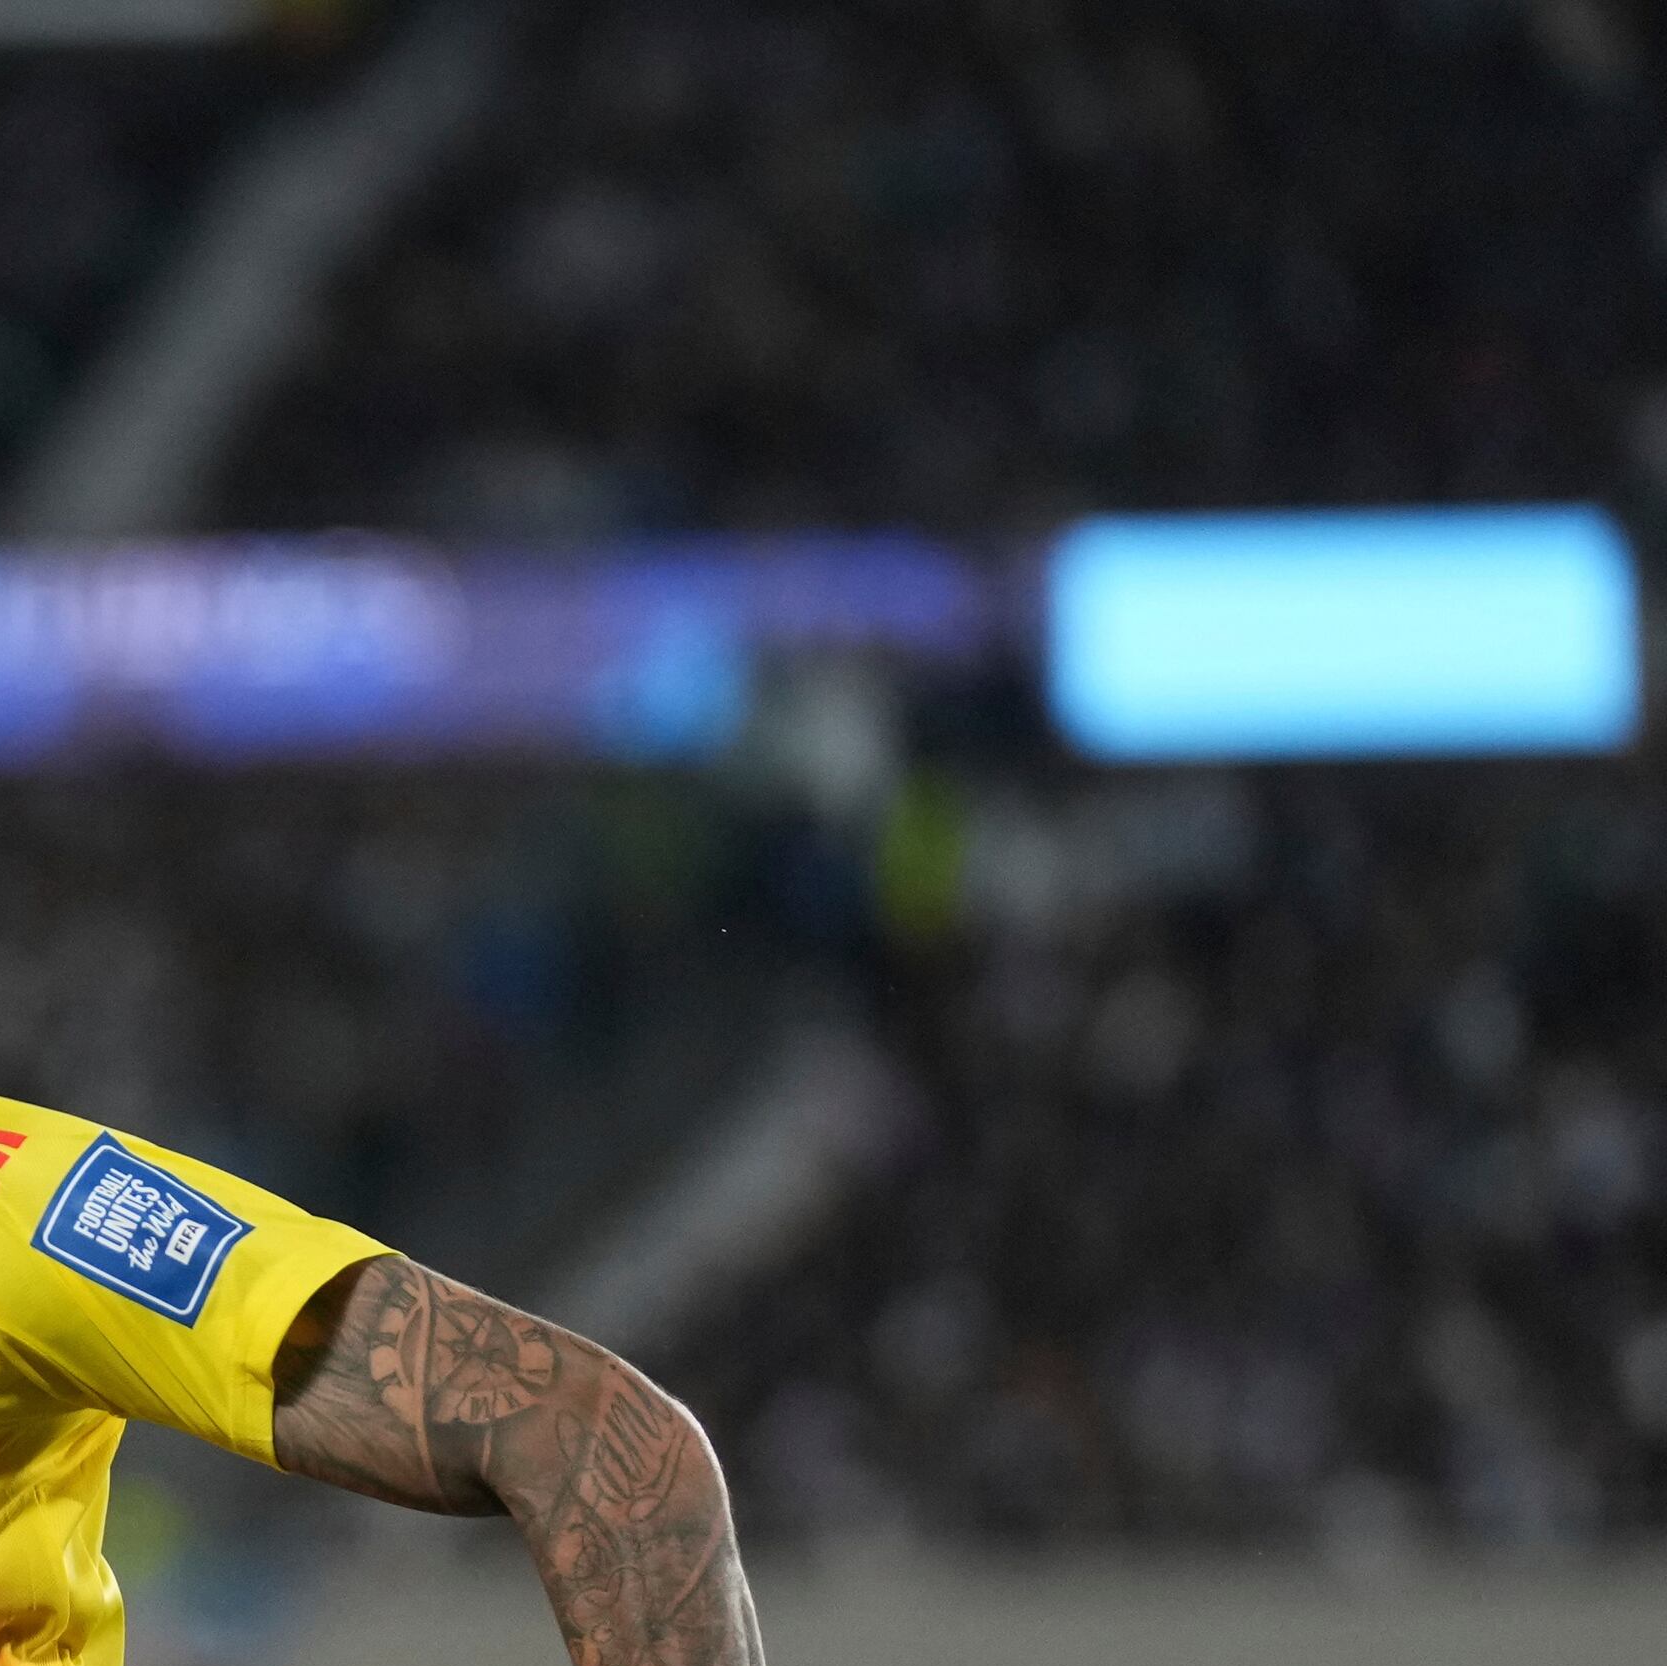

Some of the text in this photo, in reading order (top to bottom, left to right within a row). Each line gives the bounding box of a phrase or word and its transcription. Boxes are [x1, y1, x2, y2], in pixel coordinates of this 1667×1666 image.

[73, 1167, 133, 1239] FOOTBALL
[95, 1178, 161, 1253] UNITES
[127, 1236, 159, 1271] the
[173, 1223, 200, 1255] FIFA
